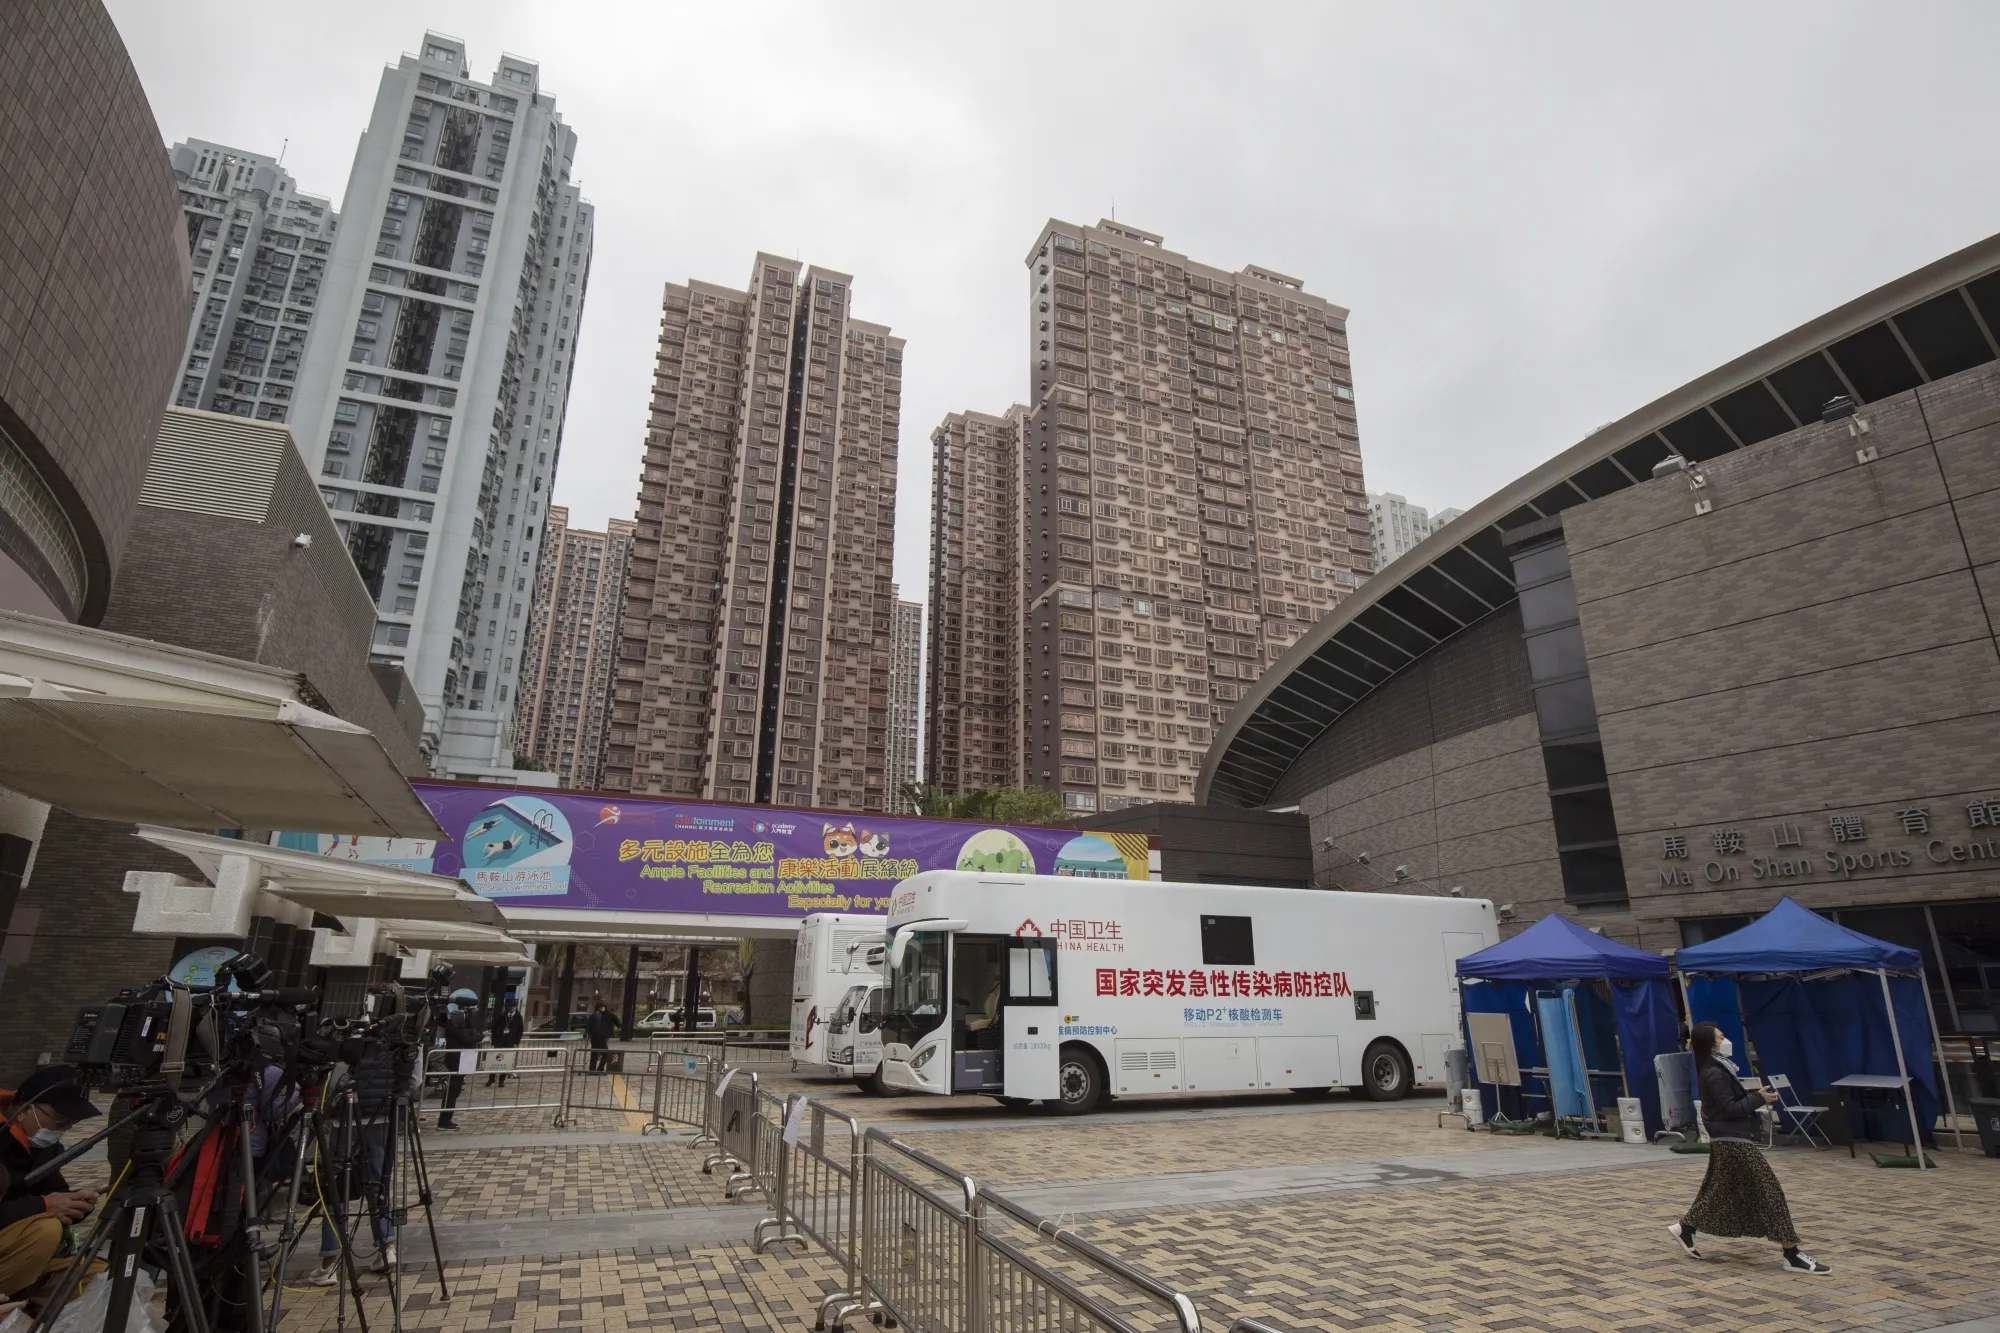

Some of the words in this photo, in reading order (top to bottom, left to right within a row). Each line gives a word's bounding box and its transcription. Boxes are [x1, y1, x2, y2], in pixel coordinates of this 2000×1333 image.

[1661, 798, 2000, 860] 馬鞍山體育館
[618, 839, 775, 862] 多元設施全為您
[640, 864, 685, 881] Ample
[687, 864, 747, 880] Facilities
[749, 866, 774, 880] and
[778, 858, 918, 880] 康樂活動展繽紛
[1658, 866, 1693, 888] Ma
[1703, 861, 1740, 883] On
[1752, 856, 1812, 879] Shan
[1824, 846, 1912, 878] Sports
[475, 871, 552, 883] 馬鞍山游泳池
[486, 884, 507, 892] Shan
[508, 883, 548, 892] Swimming
[549, 882, 568, 890] Pool
[702, 880, 775, 894] Recreation
[777, 880, 834, 894] Activities
[787, 895, 852, 910] Especially
[854, 895, 872, 908] for
[873, 898, 891, 911] yo
[1050, 919, 1123, 940] 中国卫生
[1057, 942, 1082, 951] HINA
[1087, 943, 1124, 952] HEALTH
[1095, 968, 1353, 998] 国家突发急性传染病防控队
